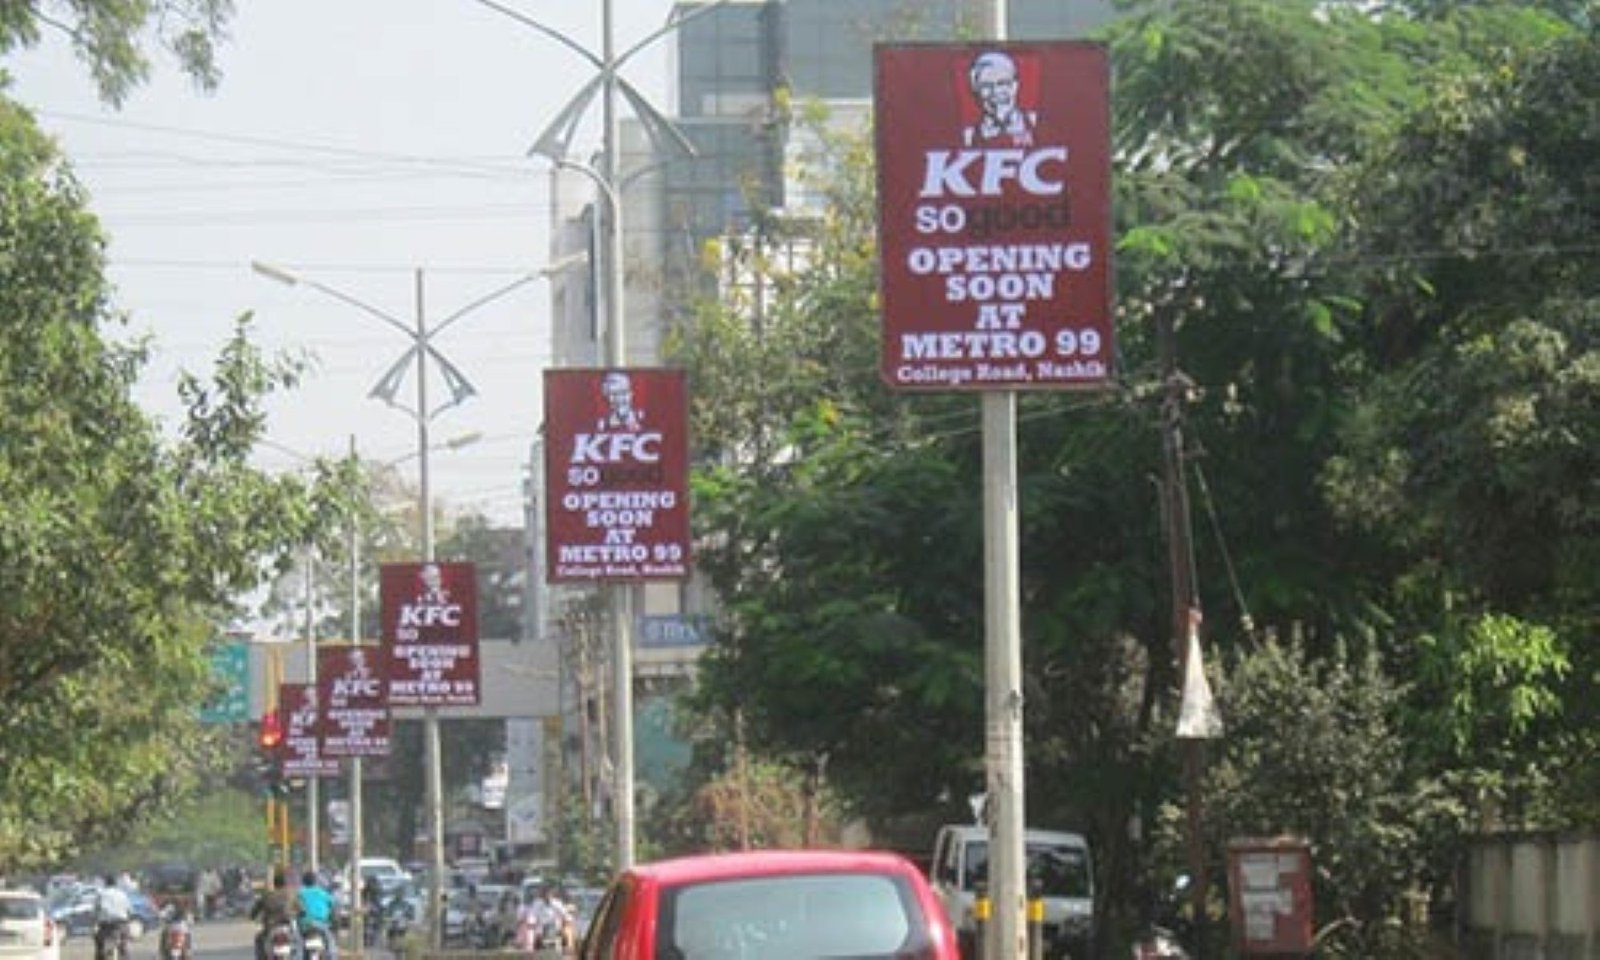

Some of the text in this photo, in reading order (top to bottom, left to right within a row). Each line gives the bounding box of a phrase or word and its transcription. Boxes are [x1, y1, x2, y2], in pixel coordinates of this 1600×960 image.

[920, 148, 1068, 197] KFC
[909, 244, 1091, 273] OPENING
[947, 274, 1054, 300] SOON
[976, 304, 1025, 329] AT
[902, 330, 1101, 359] METRO 99
[898, 366, 972, 383] College
[572, 433, 662, 463] KFC
[563, 492, 675, 510] OPENING
[587, 511, 653, 527] SOON
[606, 529, 636, 543] AT
[560, 545, 682, 562] METRO 99
[400, 606, 461, 626] KFC
